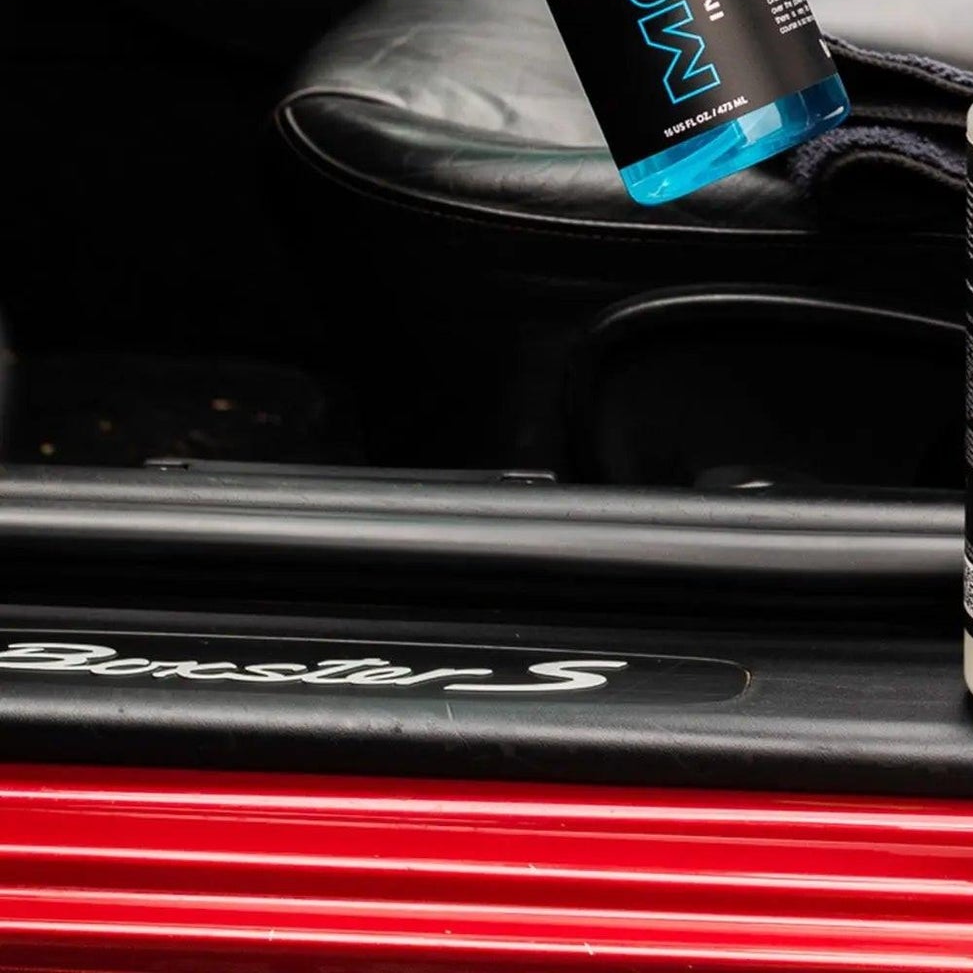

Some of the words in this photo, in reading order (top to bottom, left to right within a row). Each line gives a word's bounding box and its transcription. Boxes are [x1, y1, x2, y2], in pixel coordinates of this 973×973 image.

[664, 127, 674, 137] 16
[673, 123, 686, 133] US
[685, 118, 697, 128] FL
[696, 111, 712, 124] OZ.
[717, 101, 733, 114] 473
[733, 95, 748, 108] ML
[0, 642, 493, 687] Boxster
[443, 659, 629, 693] S
